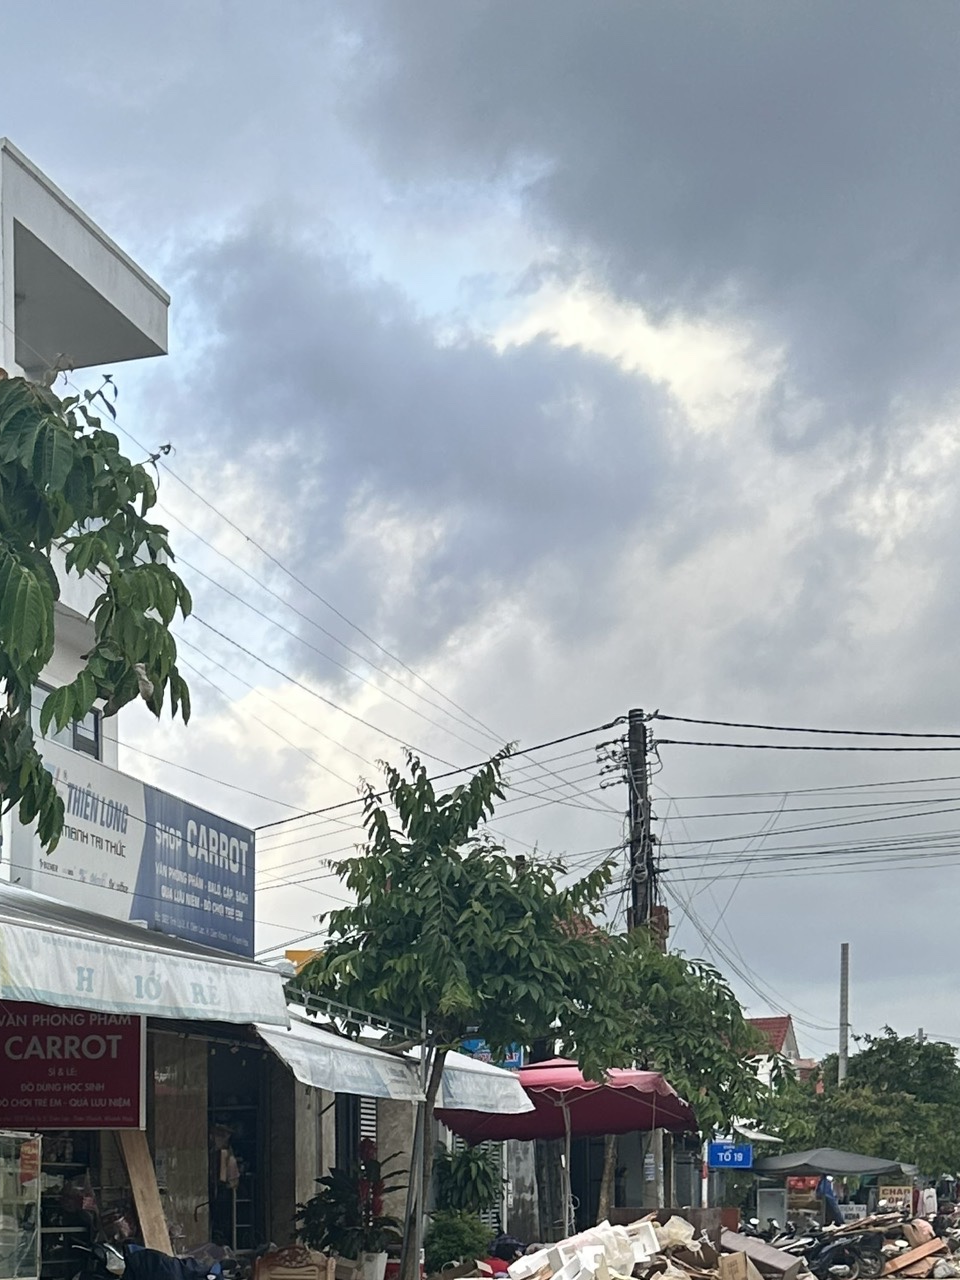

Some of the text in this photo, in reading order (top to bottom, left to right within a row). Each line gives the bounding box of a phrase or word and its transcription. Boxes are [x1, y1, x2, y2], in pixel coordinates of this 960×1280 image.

[66, 783, 129, 835] THIÊN LONG
[155, 820, 248, 876] SHOP CARROT
[4, 1034, 122, 1060] CARROT
[84, 1083, 105, 1092] SINH
[734, 1152, 743, 1162] 19
